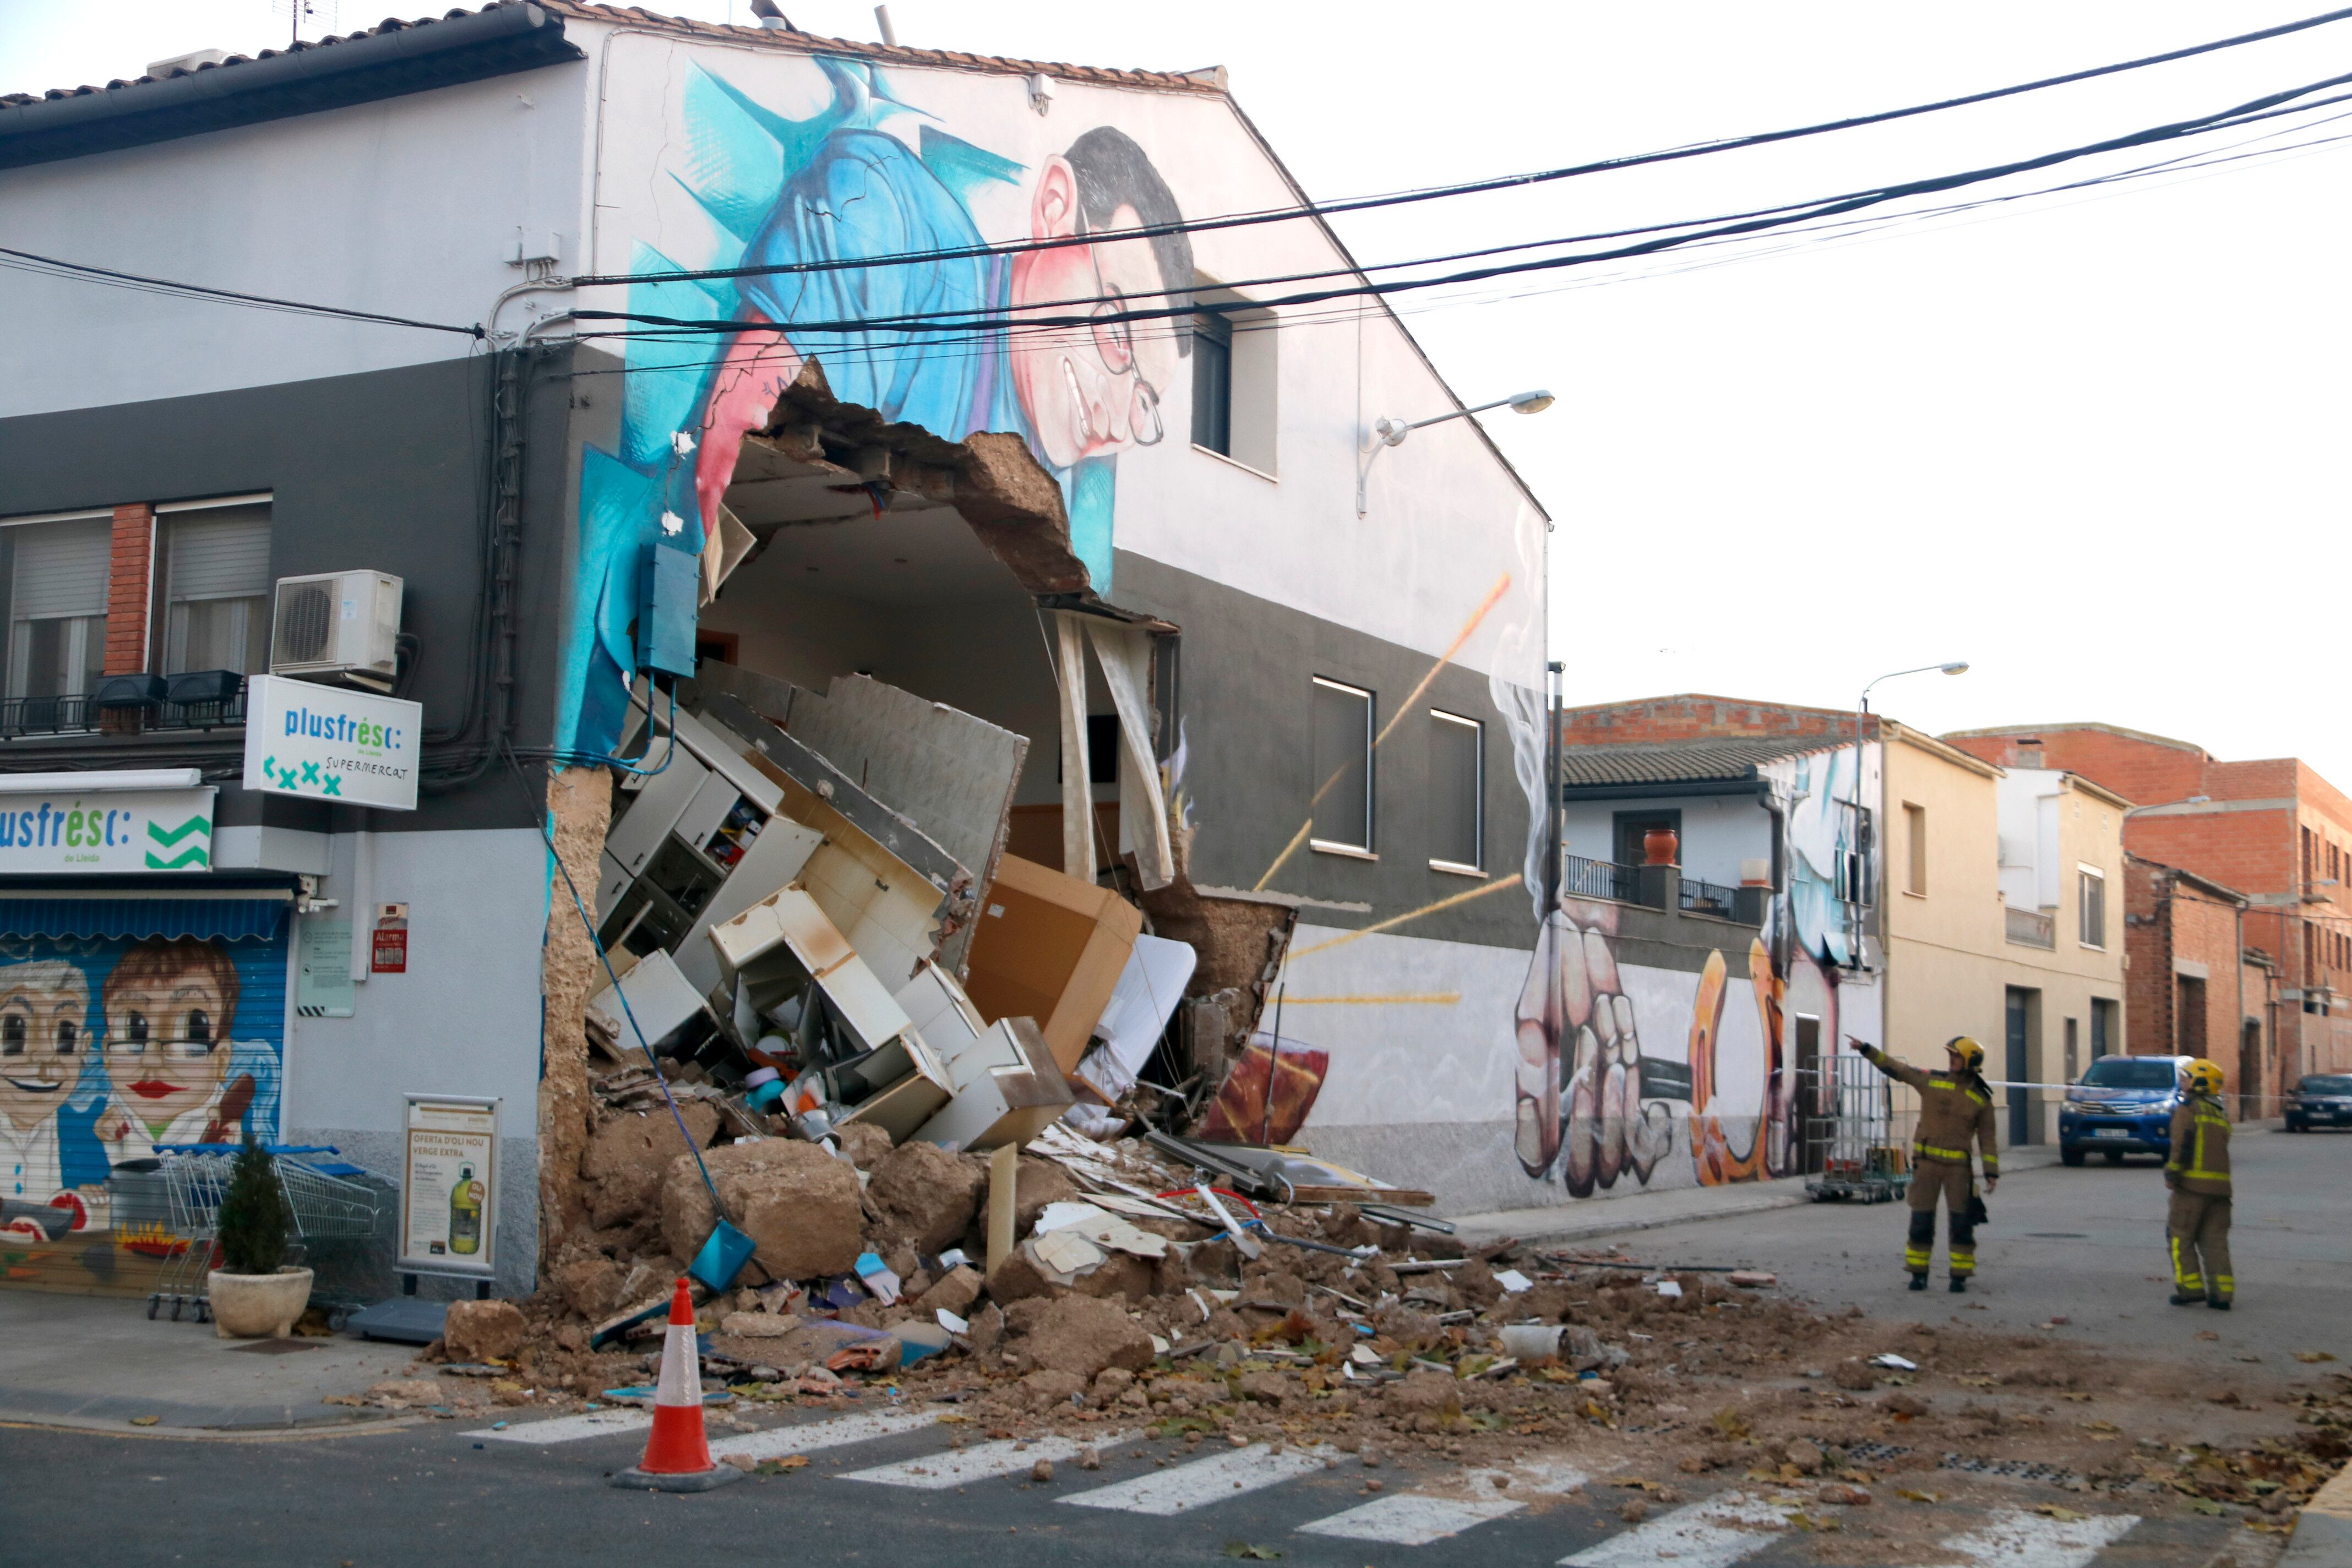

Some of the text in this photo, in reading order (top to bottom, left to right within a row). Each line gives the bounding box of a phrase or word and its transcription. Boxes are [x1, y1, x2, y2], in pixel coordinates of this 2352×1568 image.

[413, 1135, 484, 1147] OFERTA D'OLI NOU
[413, 1146, 464, 1157] VERGE EXTRA
[472, 1183, 482, 1191] OLI
[469, 1191, 482, 1200] NOU
